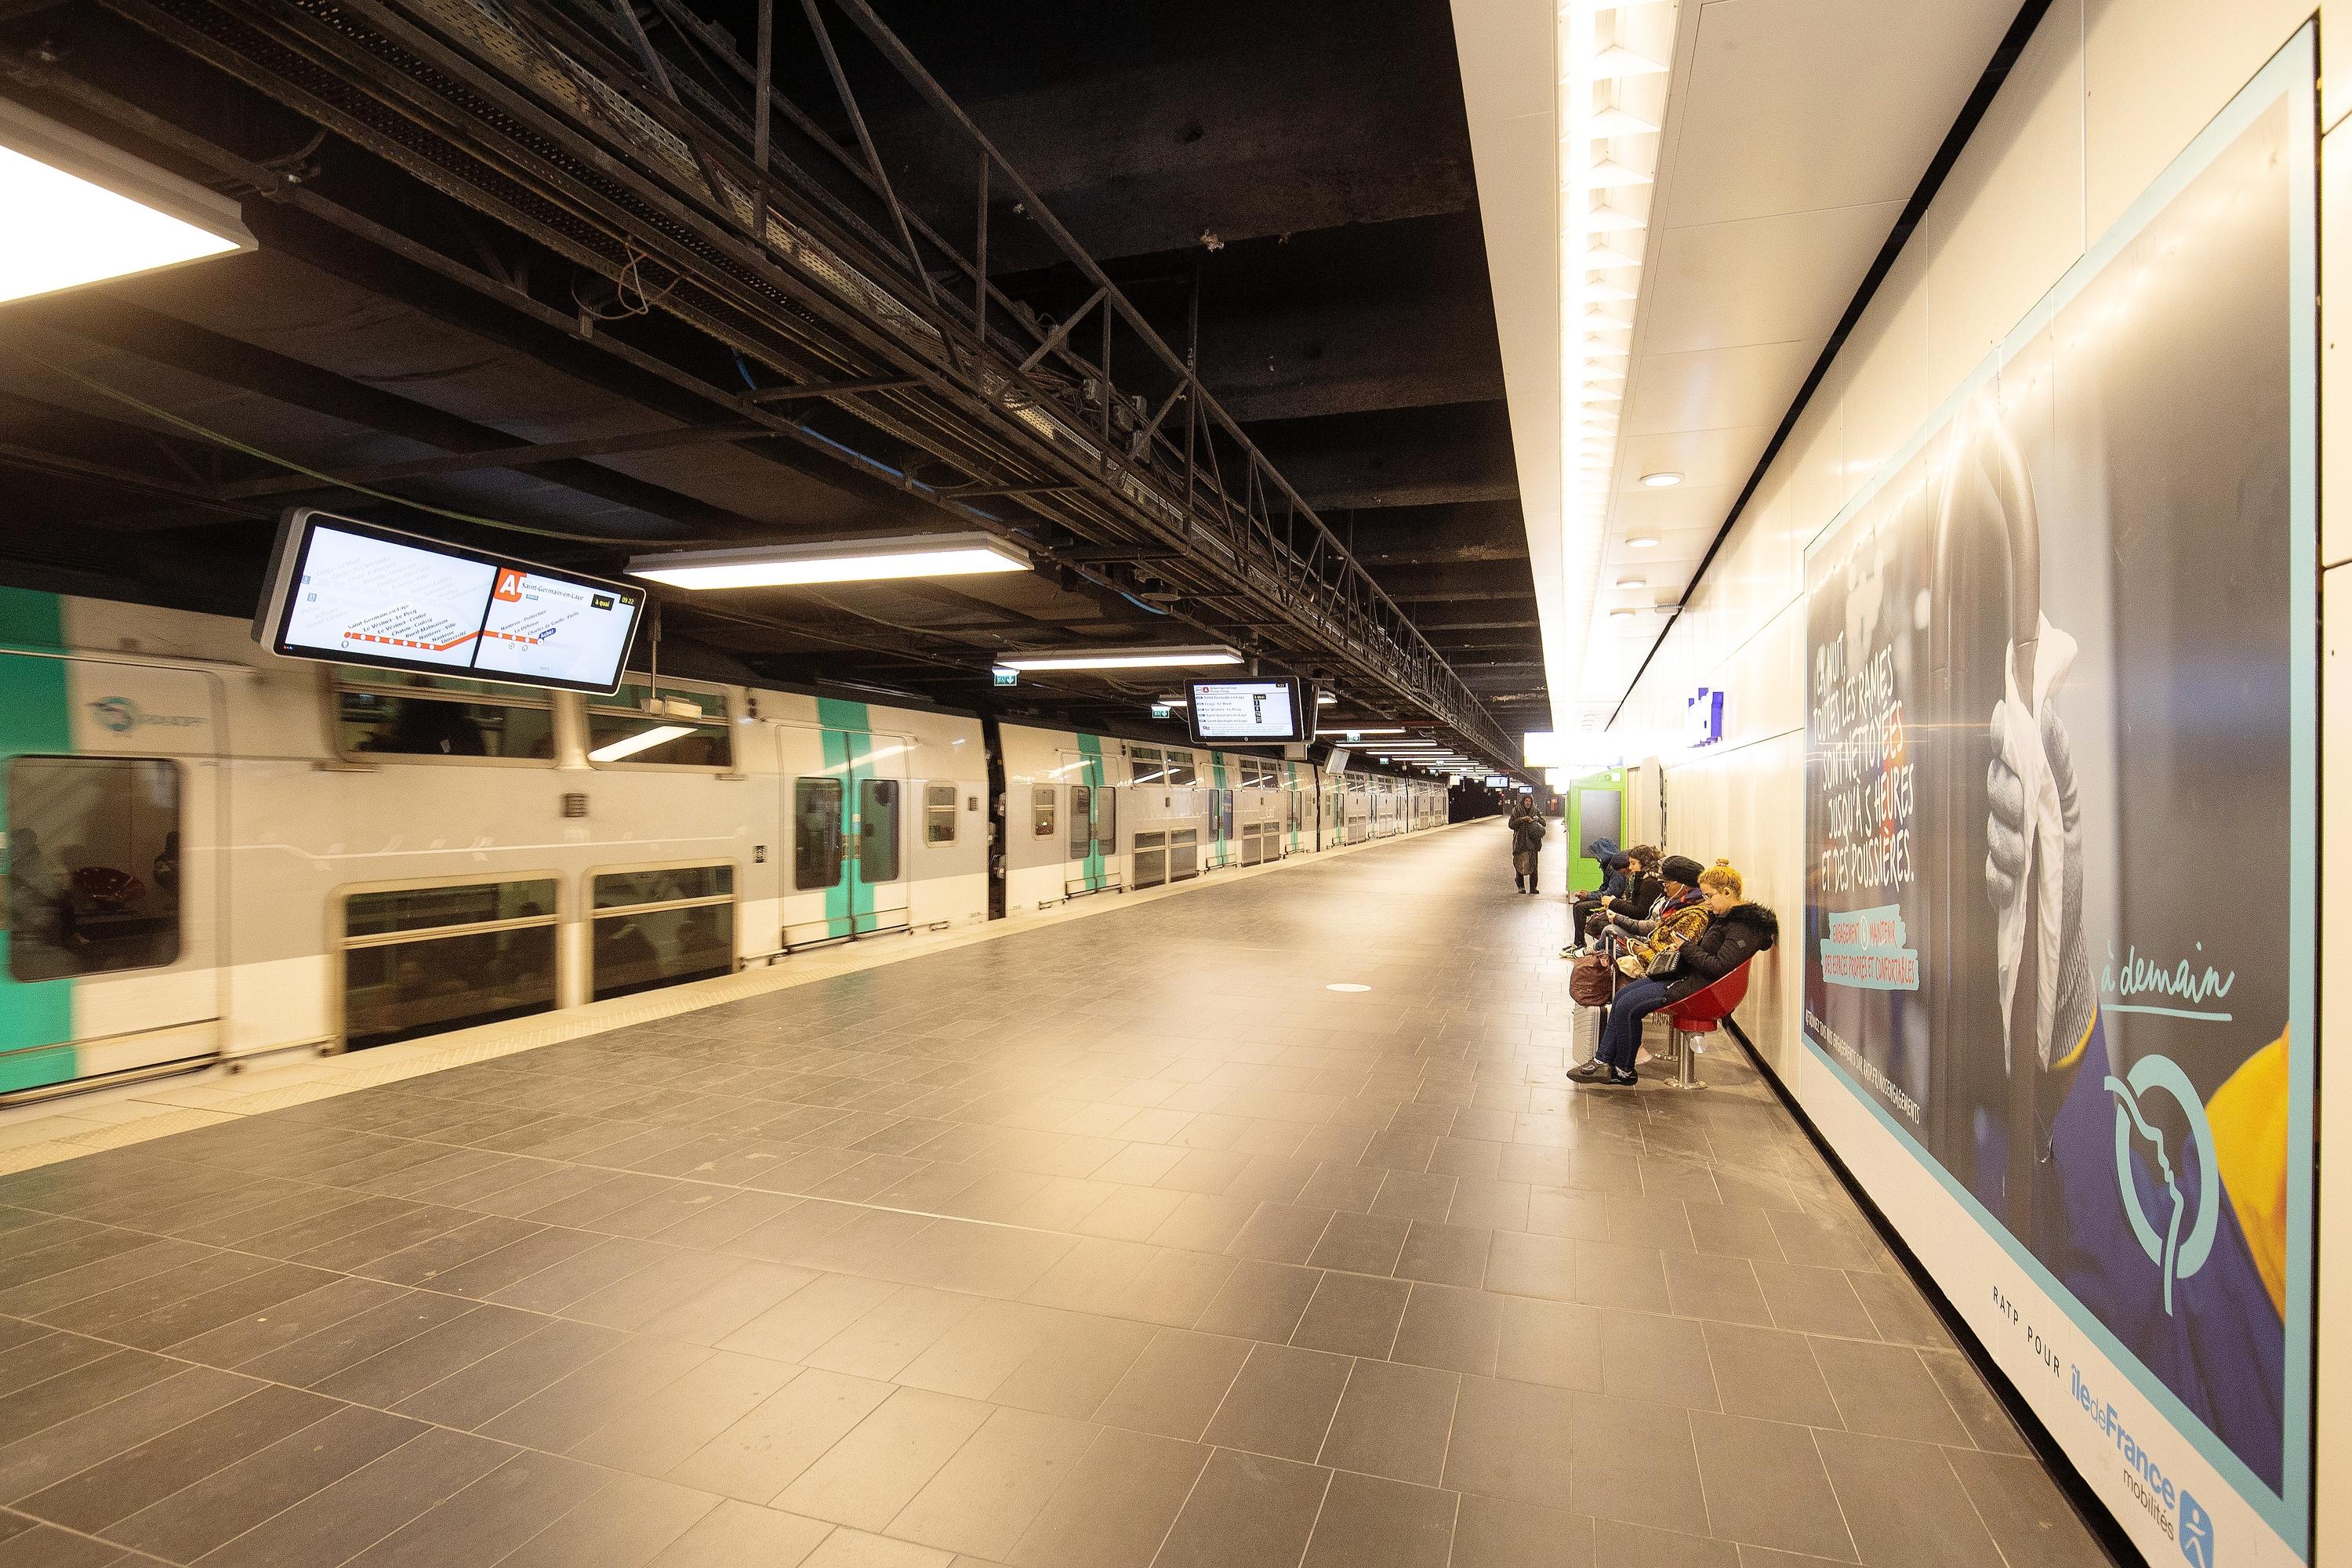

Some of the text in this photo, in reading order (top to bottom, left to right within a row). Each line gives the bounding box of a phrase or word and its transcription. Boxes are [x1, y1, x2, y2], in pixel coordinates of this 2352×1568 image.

[499, 574, 516, 596] A
[1813, 644, 1893, 746] TOUTES LES RAMES
[1817, 652, 1826, 696] LA
[1823, 700, 1904, 791] SONT NETTOYÉES
[1828, 776, 1862, 847] JUSQU'À
[1874, 763, 1914, 828] HEURES
[1822, 826, 1914, 894] ET DES POUSSIÈRES.
[1869, 919, 1897, 948] MAINTENIR
[1833, 955, 1848, 976] ESPACES
[1849, 955, 1867, 981] PROPRES
[1868, 956, 1874, 978] ET
[1876, 956, 1914, 985] CONFORTABLES
[2100, 939, 2235, 1004] à demain
[1993, 1285, 2060, 1378] RATP POUR
[2123, 1468, 2174, 1541] mobilités
